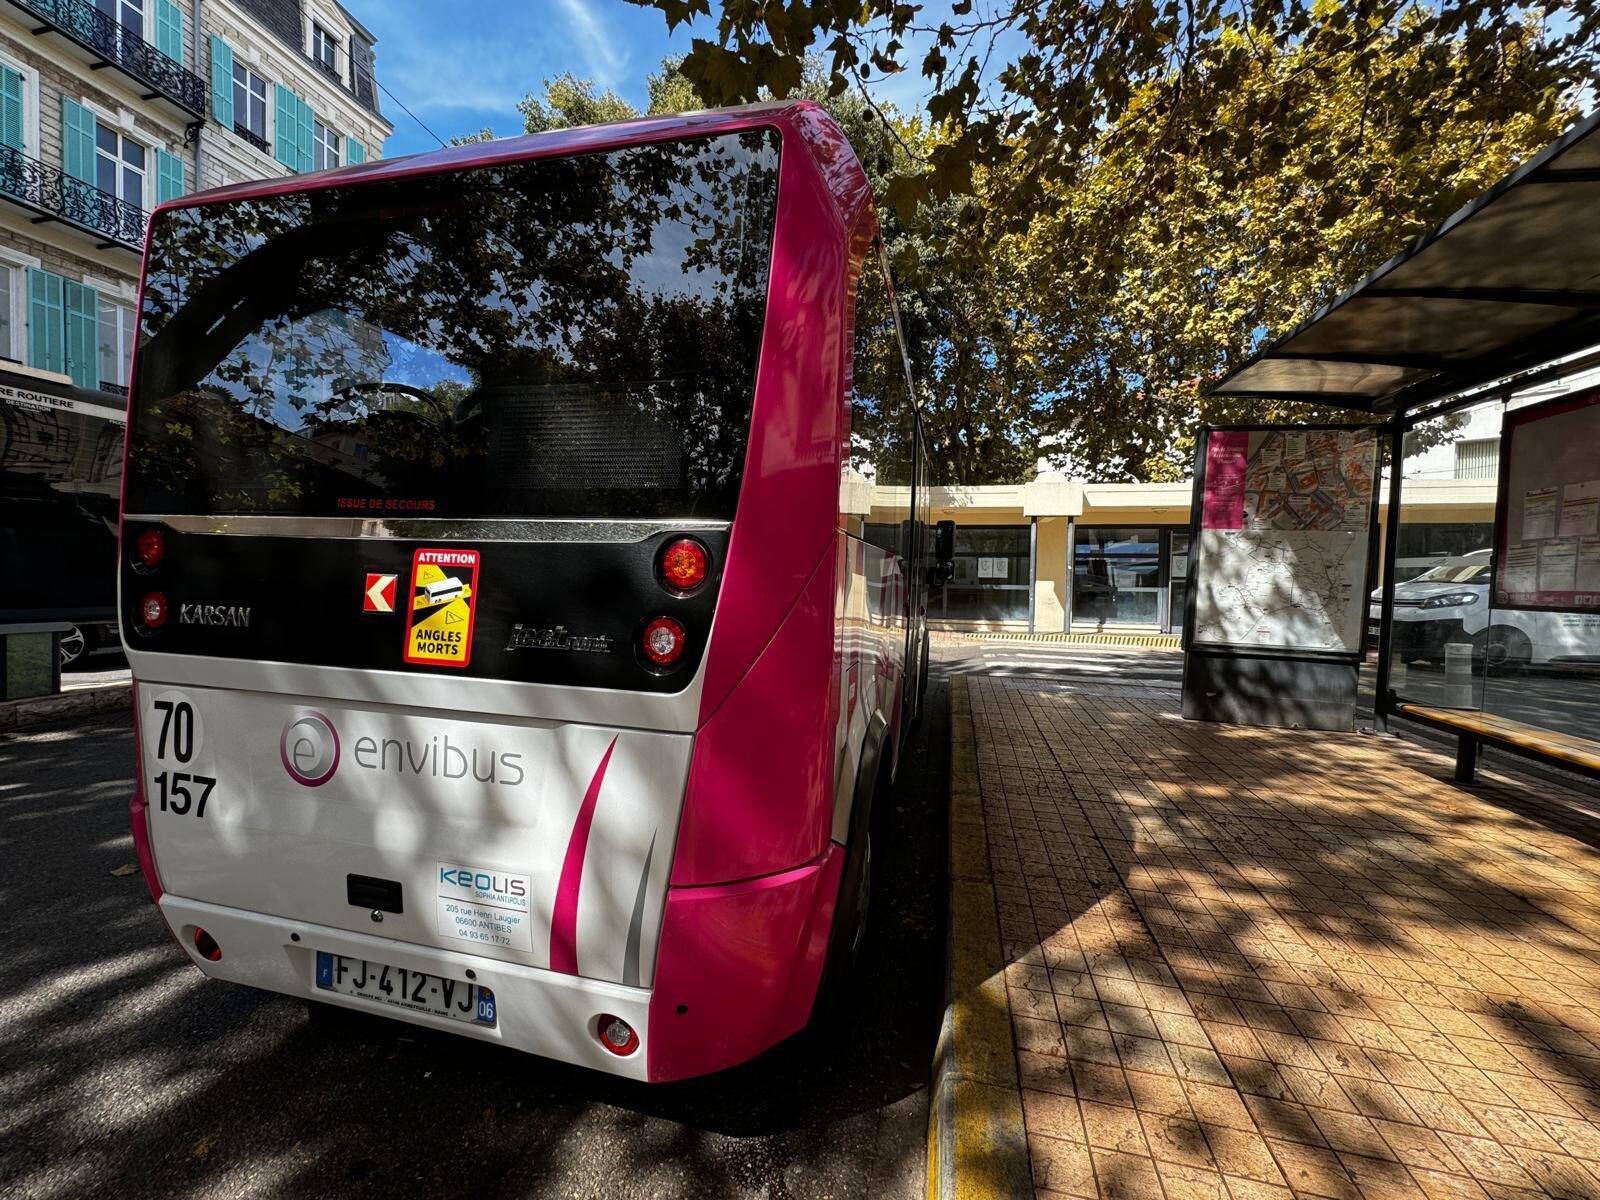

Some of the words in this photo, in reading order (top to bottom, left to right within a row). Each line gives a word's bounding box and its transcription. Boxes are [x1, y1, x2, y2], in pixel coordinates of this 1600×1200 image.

[17, 391, 74, 409] ROUTIERE
[337, 497, 367, 508] ISSUE
[369, 498, 383, 509] DE
[385, 498, 436, 510] SECOURS
[417, 551, 476, 565] ATTENTION
[179, 603, 251, 628] KARSAN
[415, 628, 462, 643] ANGLES
[416, 641, 459, 656] MORTS
[153, 700, 194, 764] 70
[354, 734, 525, 786] envibus
[154, 771, 217, 818] 157
[475, 891, 497, 901] SOPHIA
[497, 895, 526, 907] ANTIPOLIS
[446, 904, 459, 913] 205
[460, 908, 472, 916] rue
[455, 916, 477, 927] 06600
[478, 921, 512, 934] ANTIBES
[336, 955, 473, 1012] FJ-412-VJ
[478, 1002, 494, 1019] 06
